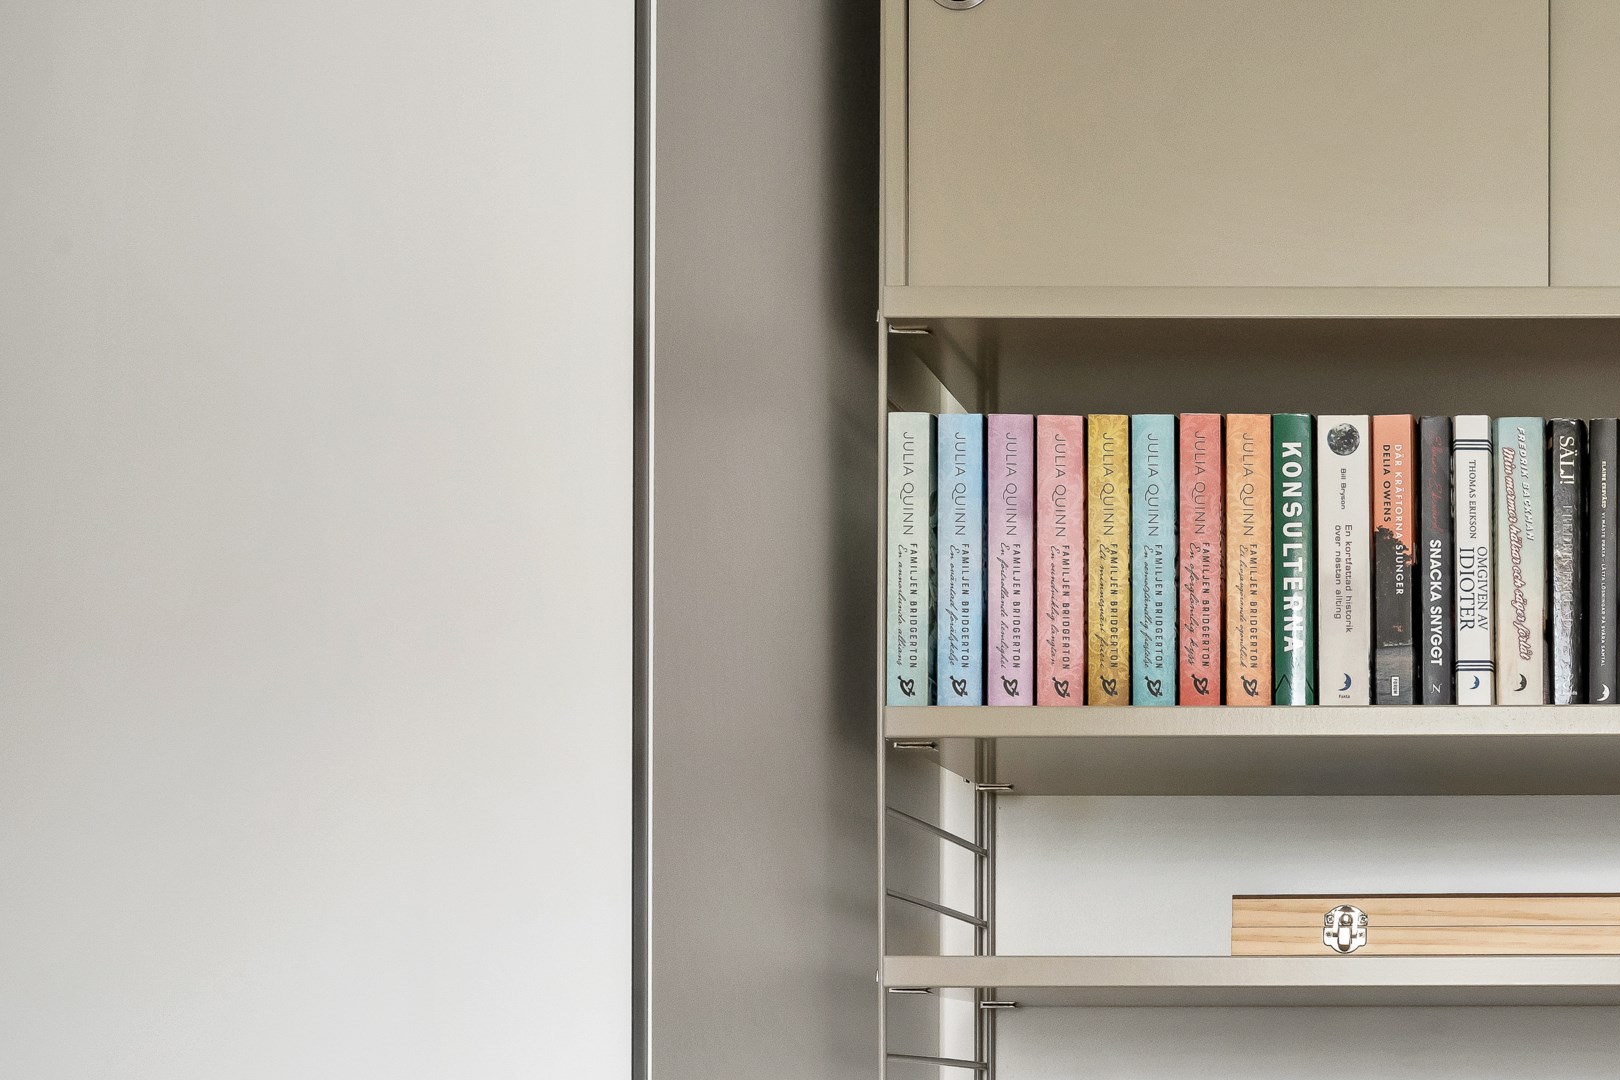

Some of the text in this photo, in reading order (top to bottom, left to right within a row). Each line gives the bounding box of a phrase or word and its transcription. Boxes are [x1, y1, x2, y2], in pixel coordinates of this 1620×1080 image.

[900, 432, 914, 535] JULIA QUINN
[952, 432, 966, 535] JULIA QUINN
[1003, 432, 1017, 536] JULIA QUINN
[1052, 433, 1066, 537] JULIA QUINN
[1100, 432, 1114, 536] JULIA QUINN
[1145, 433, 1159, 537] JULIA QUINN
[1191, 431, 1205, 534] JULIA QUINN
[1240, 433, 1254, 536] JULIA QUINN
[1339, 482, 1347, 510] Bryson
[1382, 444, 1391, 522] DELIA OWENS
[1469, 460, 1477, 539] THOMAS ERIKSON
[1517, 427, 1535, 541] FREDRIK BACKMAN
[1559, 435, 1577, 485] SÄLJ!
[898, 544, 908, 558] En
[950, 545, 960, 559] En
[1000, 542, 1010, 556] En
[1050, 546, 1060, 560] En
[1144, 545, 1153, 558] En
[1189, 542, 1200, 558] En
[1282, 442, 1303, 653] KONSULTERNA
[1394, 444, 1404, 595] DÄR KRÄFTORNA SJUNGER
[1502, 447, 1533, 661] Min mormor hälsar och säger förlåt
[909, 544, 918, 668] FAMILJEN BRIDGERTON
[961, 544, 969, 668] FAMILJEN BRIDGERTON
[1062, 545, 1070, 670] FAMILJEN BRIDGERTON
[1110, 544, 1118, 668] FAMILJEN BRIDGERTON
[1155, 545, 1163, 668] FAMILJEN BRIDGERTON
[1202, 542, 1210, 667] FAMILJEN BRIDGERTON
[1250, 544, 1258, 668] FAMILJEN BRIDGERTON
[1333, 525, 1343, 619] över nästan allting
[1344, 524, 1352, 633] En kortfattad historik
[1429, 539, 1442, 666] SNACKA SNYGGT
[1459, 547, 1475, 631] IDIOTER
[1477, 546, 1488, 631] OMGIVEN AV
